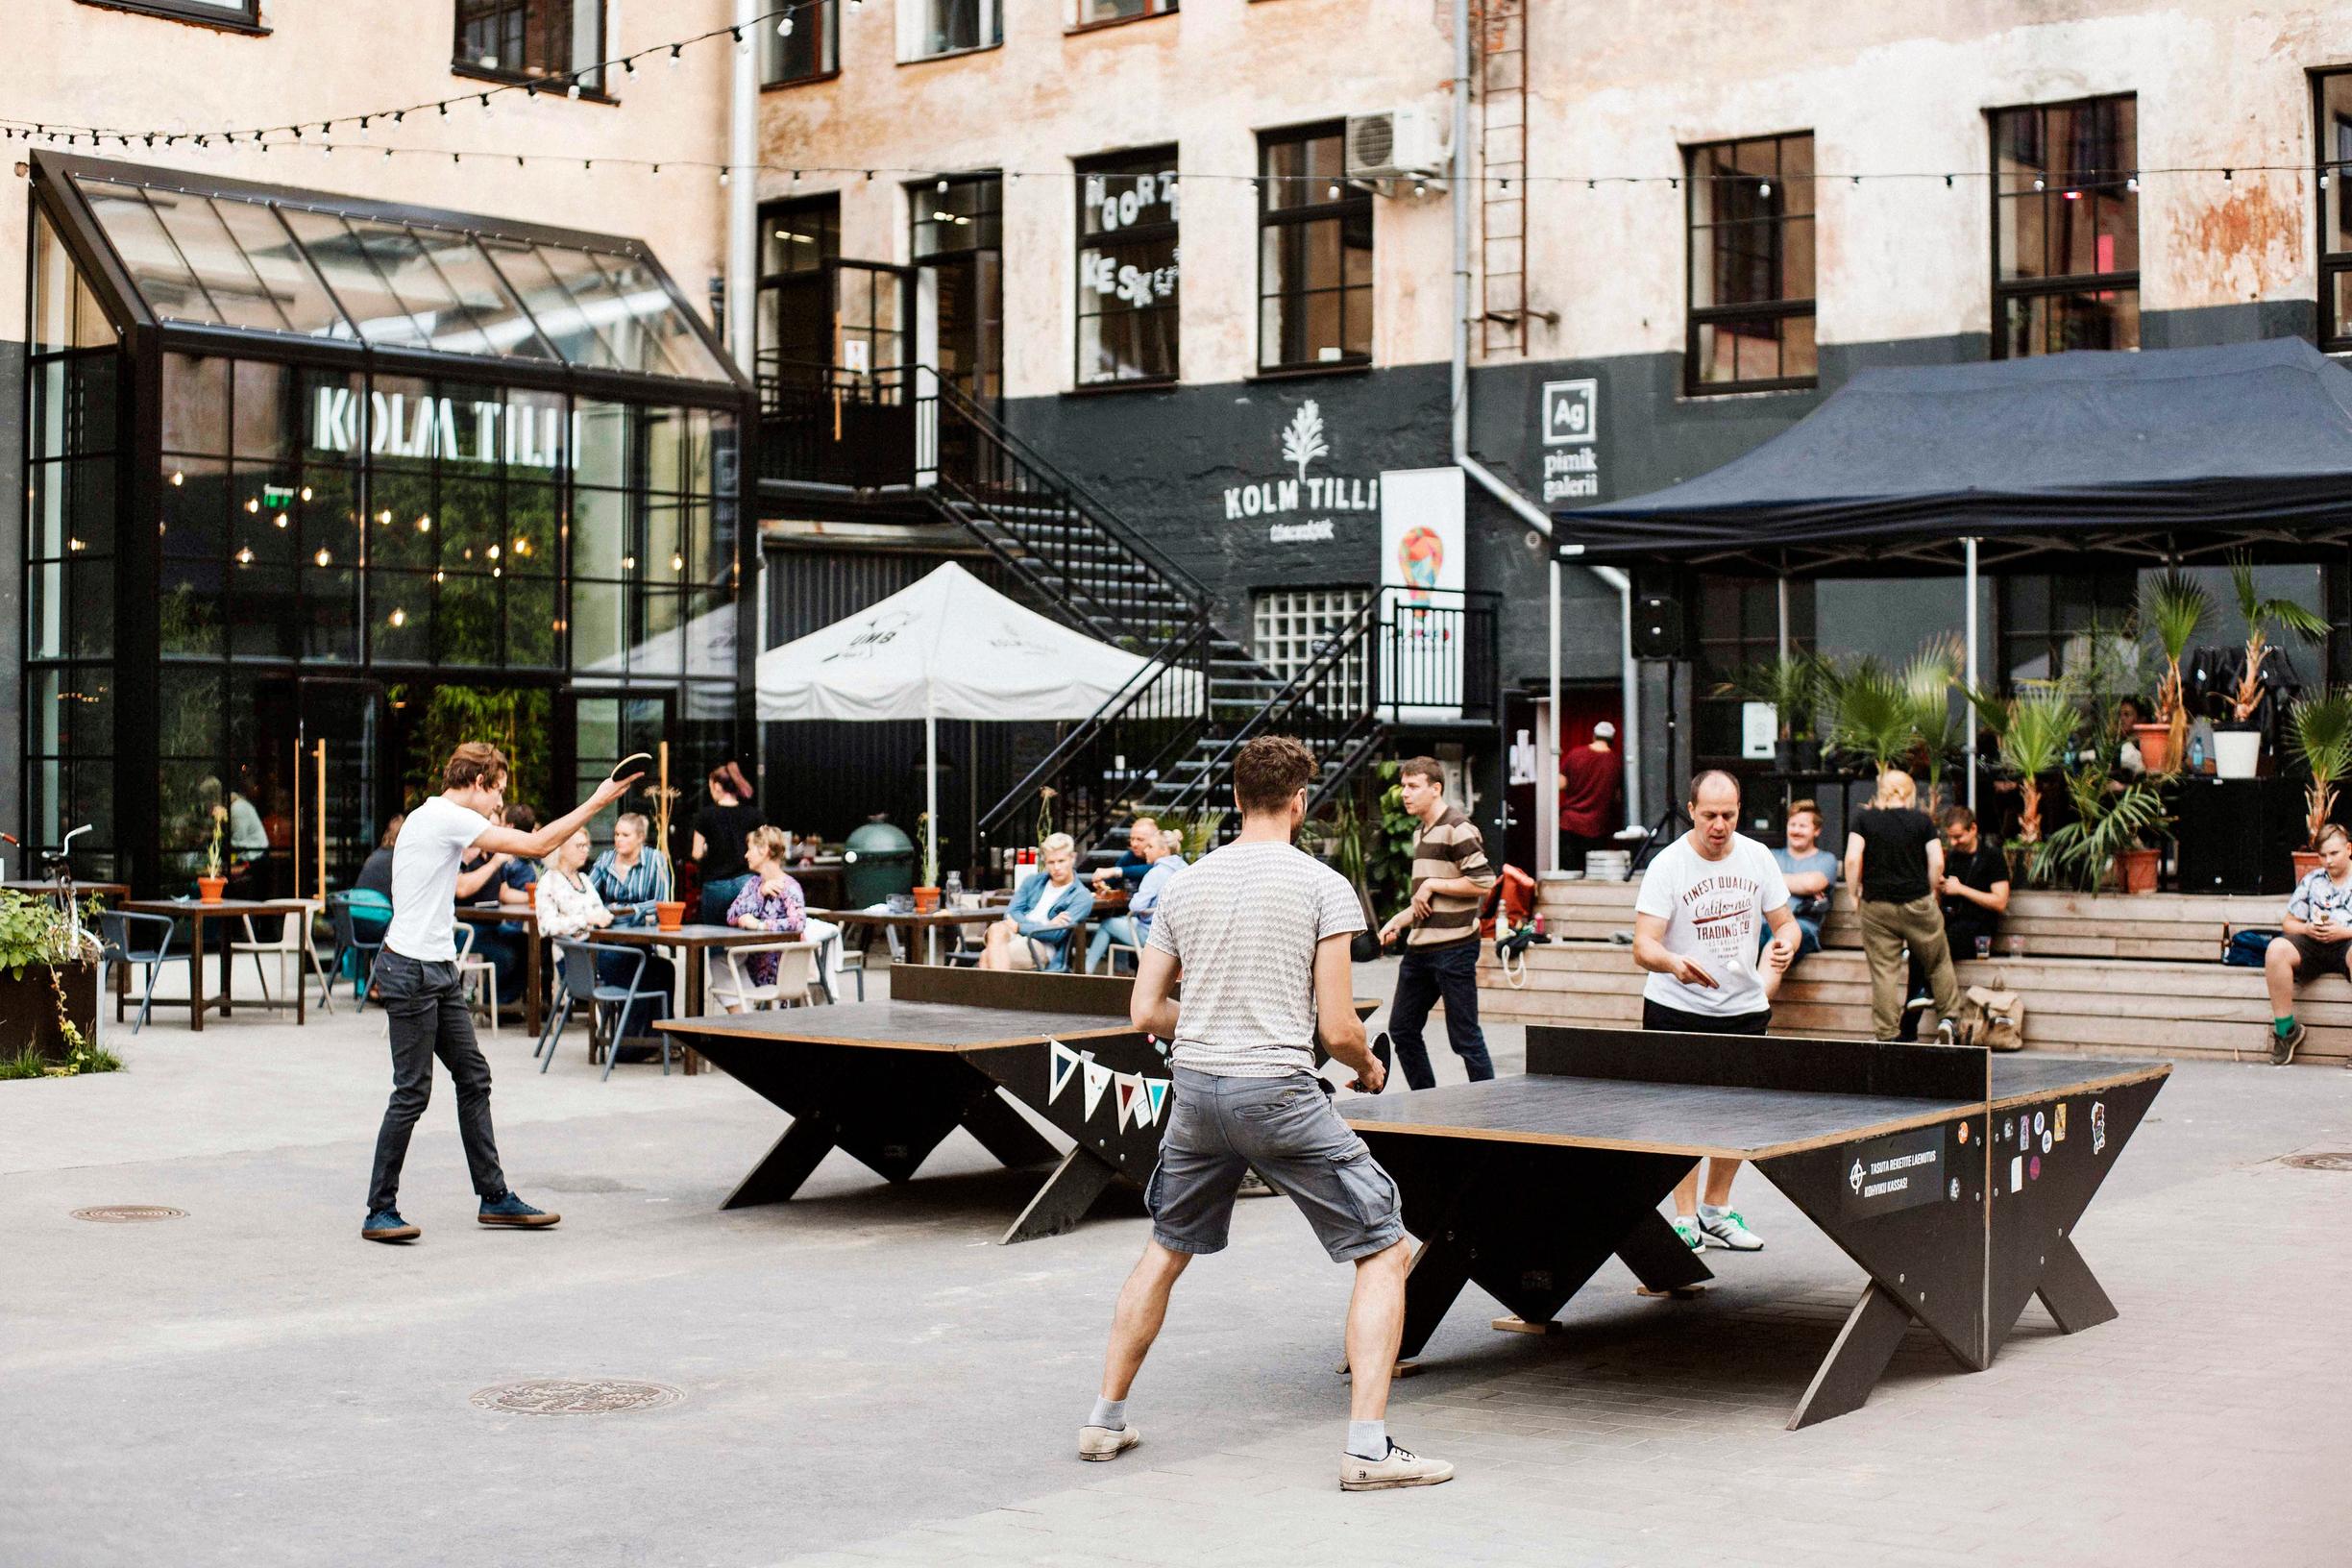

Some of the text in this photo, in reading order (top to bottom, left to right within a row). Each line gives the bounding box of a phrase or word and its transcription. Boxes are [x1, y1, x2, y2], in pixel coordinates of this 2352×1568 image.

[1554, 399, 1585, 430] Ag
[1224, 478, 1378, 520] KOLM TILLI
[1682, 876, 1759, 906] FINEST QUALITY
[1697, 924, 1738, 941] TRADING
[1871, 1160, 1890, 1175] TASUTA
